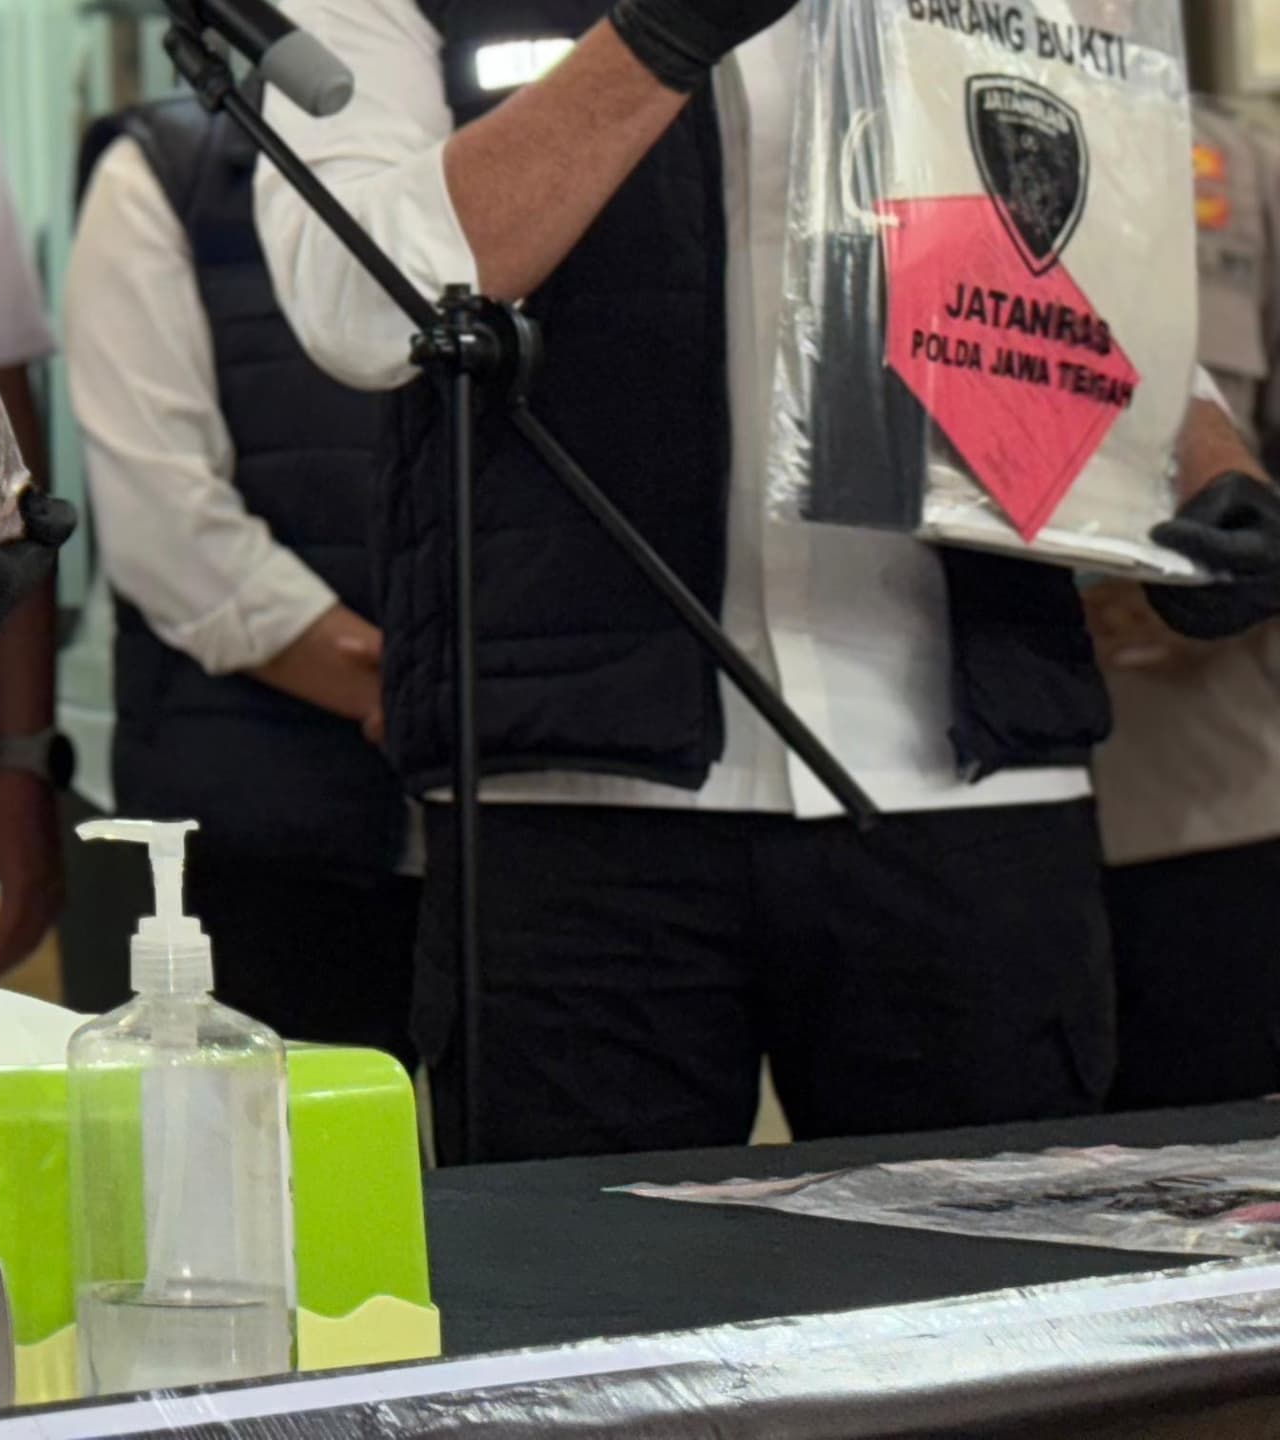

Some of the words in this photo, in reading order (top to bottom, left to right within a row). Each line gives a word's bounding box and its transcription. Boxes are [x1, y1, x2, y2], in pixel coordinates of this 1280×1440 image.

[1034, 16, 1127, 80] BUKTI
[945, 282, 1111, 356] JATANRAS
[911, 329, 983, 372] POLDA
[990, 348, 1050, 385] JAWA
